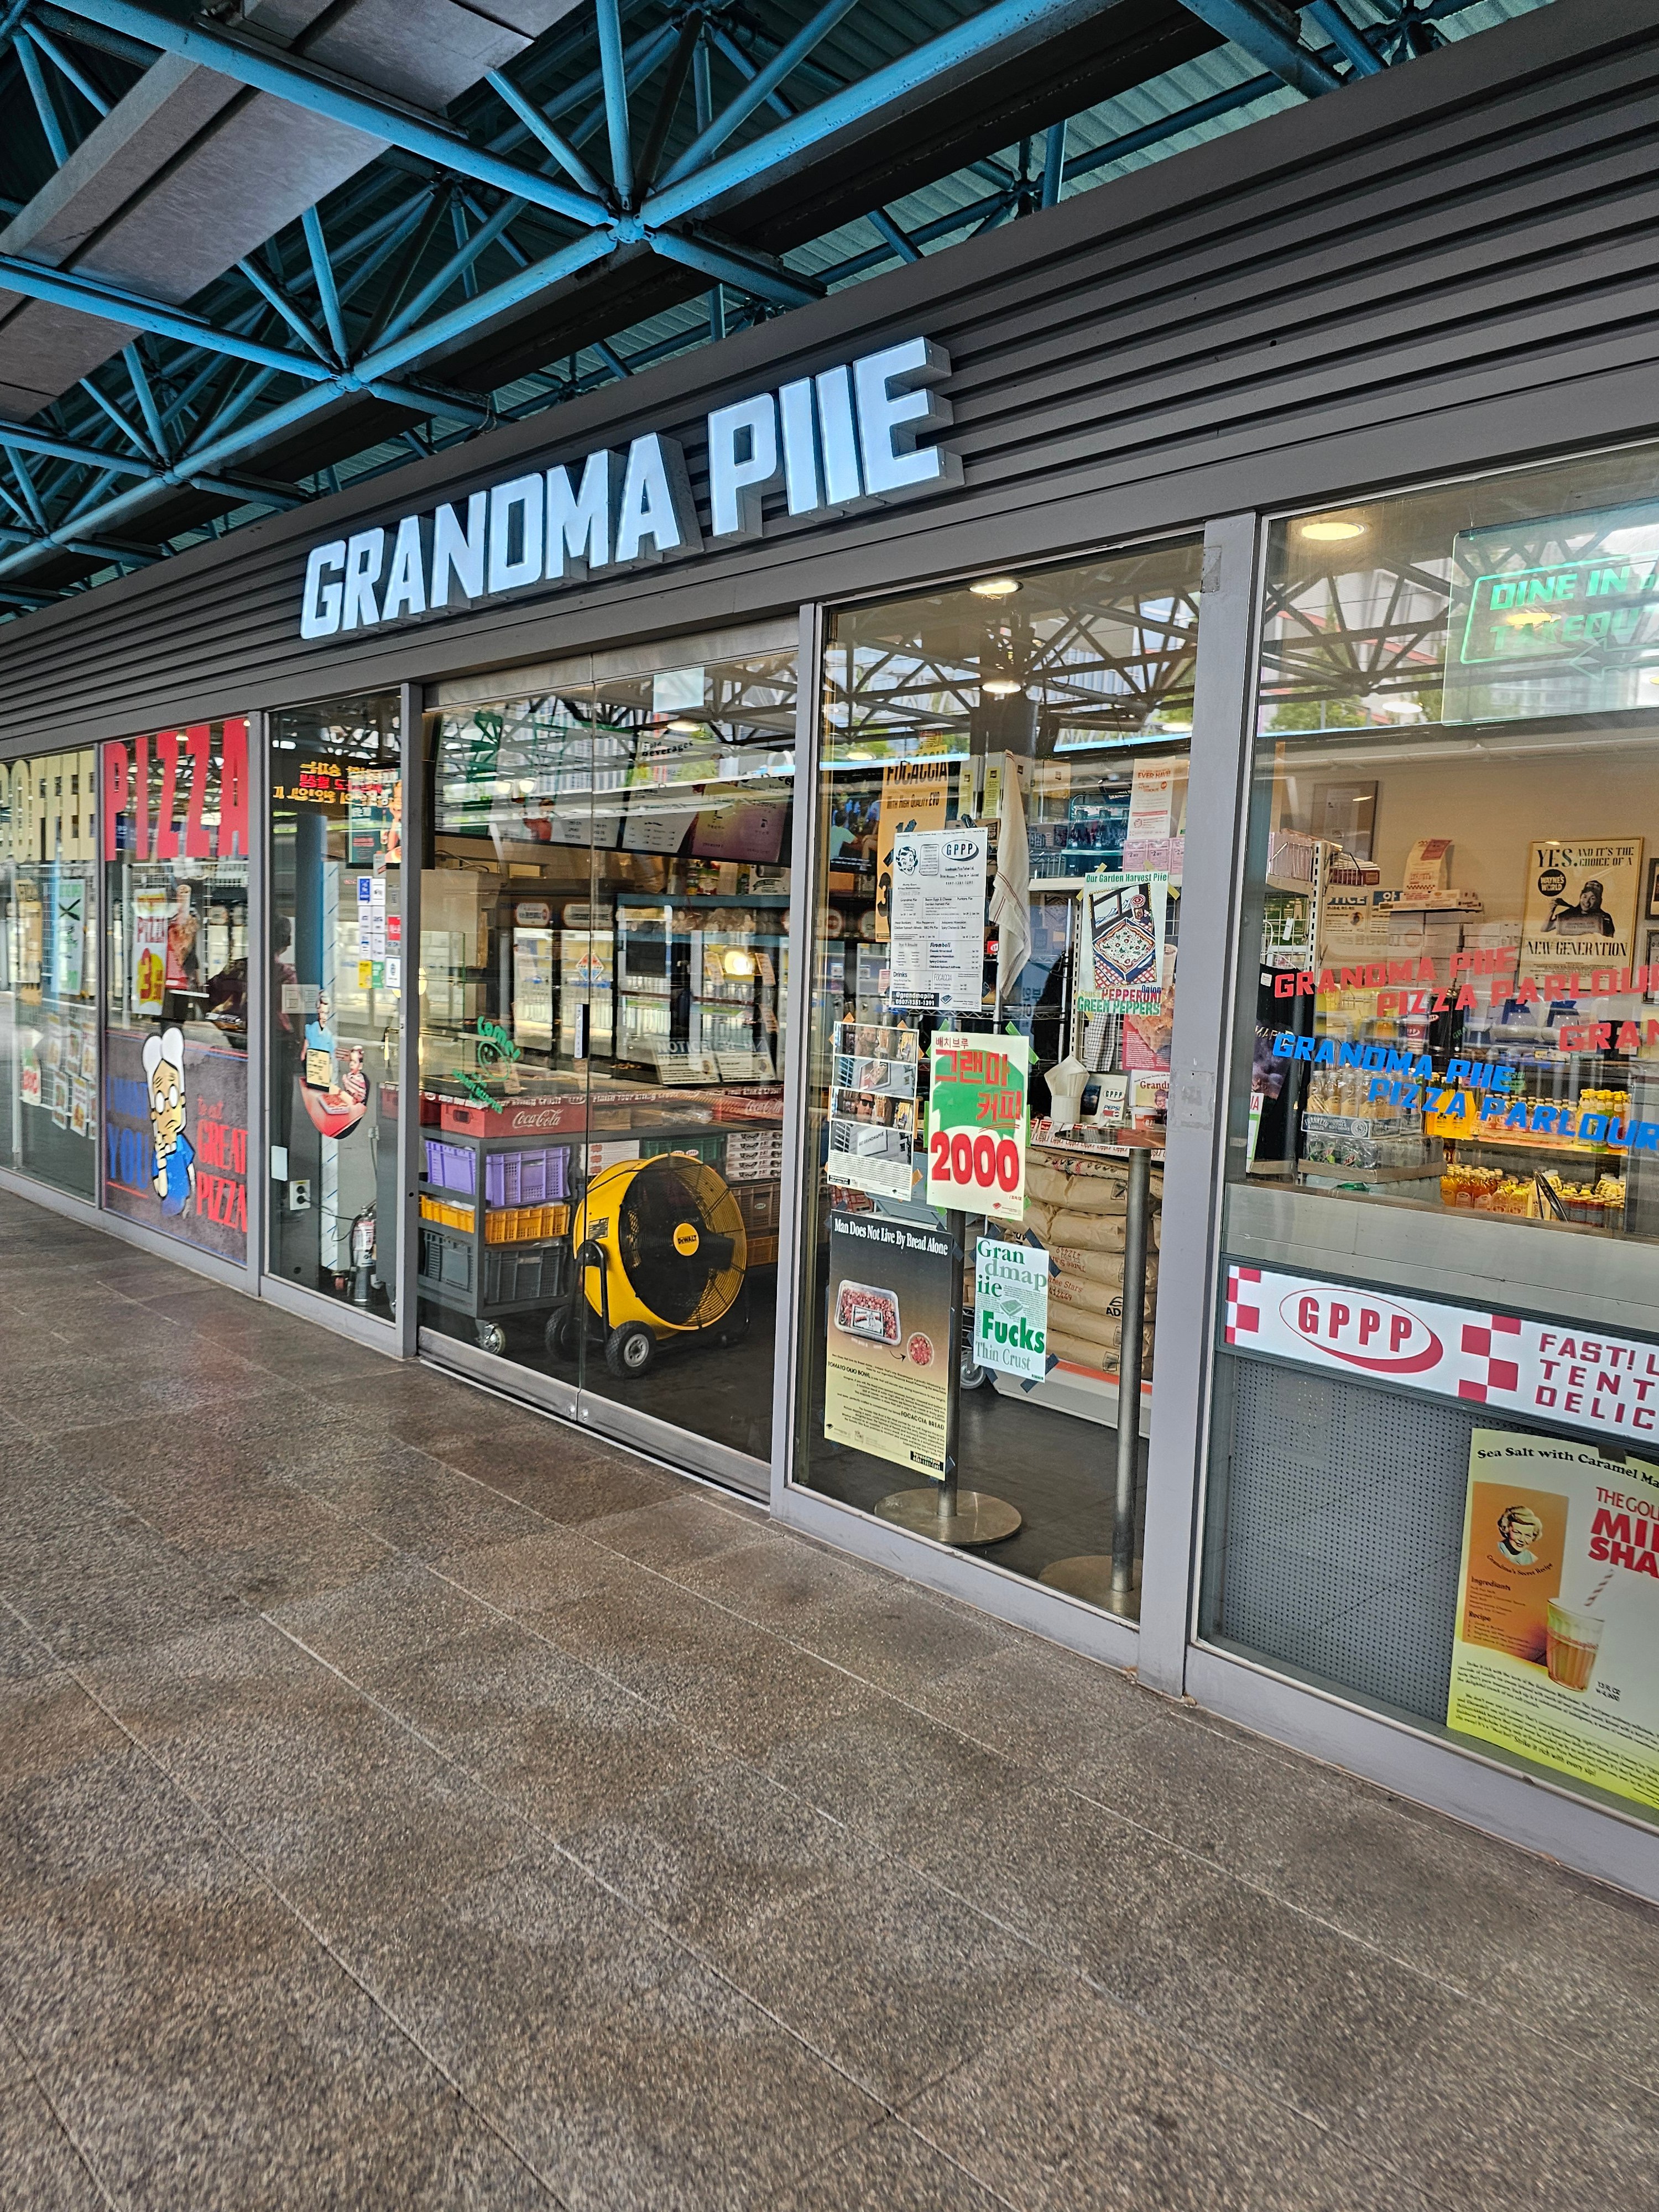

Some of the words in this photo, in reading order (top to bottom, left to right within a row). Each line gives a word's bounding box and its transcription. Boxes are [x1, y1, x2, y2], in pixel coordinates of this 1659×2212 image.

[300, 432, 691, 640] GRANDMA
[708, 336, 954, 539] PIIE
[1490, 573, 1578, 611] DINE
[1585, 566, 1631, 597] IN
[105, 717, 249, 861] PIZZA
[946, 843, 973, 855] GPPP
[1537, 848, 1578, 867] YES.
[1578, 848, 1593, 857] AND
[1596, 848, 1613, 856] IT'S
[1616, 847, 1634, 855] THE
[1579, 858, 1610, 867] CHOICE
[1613, 857, 1624, 866] OF
[1627, 857, 1632, 865] A
[1086, 874, 1098, 883] Our
[1099, 874, 1124, 883] Garden
[1125, 873, 1152, 882] Harvest
[1541, 875, 1564, 884] WAYNE'S
[1526, 940, 1551, 954] NEW
[1556, 941, 1628, 957] GENERATION
[1274, 957, 1437, 998] GRANDMA
[1450, 946, 1518, 978] PIIE
[1077, 996, 1110, 1013] GREEN
[1113, 999, 1160, 1015] PEPPERS
[1081, 989, 1101, 998] Sausa
[1378, 984, 1478, 1017] PIZZA
[936, 1037, 969, 1049] 배치브루
[935, 1048, 1010, 1088] 그랜마
[1272, 1033, 1432, 1080] GRANDMA
[1446, 1058, 1516, 1093] PIIE
[976, 1090, 1022, 1123] 커피
[1105, 1091, 1123, 1099] GPPP
[512, 1108, 565, 1129] Coca-Cola
[1368, 1078, 1465, 1118] PIZZA
[1481, 1096, 1659, 1151] PARLOUR
[107, 1122, 149, 1189] YOU
[196, 1118, 248, 1175] GREAT
[930, 1131, 1019, 1193] 2000
[196, 1171, 248, 1233] PIZZA
[834, 1218, 849, 1234] Man
[849, 1221, 867, 1238] Does
[867, 1225, 880, 1241] Not
[881, 1227, 895, 1244] Live
[896, 1230, 906, 1250] By
[906, 1233, 927, 1251] Bread
[926, 1237, 948, 1256] Alone
[978, 1240, 1025, 1265] Gran
[977, 1274, 1002, 1297] iie
[984, 1259, 1047, 1292] dmap
[1064, 1280, 1084, 1293] Stars
[1106, 1307, 1121, 1317] AD
[1298, 1296, 1412, 1353] GPPP
[982, 1310, 1045, 1354] Fucks
[975, 1340, 999, 1365] Thin
[1002, 1348, 1031, 1371] Crust
[1539, 1333, 1636, 1371] FAST!
[828, 1361, 846, 1371] TOMATO
[858, 1368, 871, 1379] BOWL
[901, 1411, 927, 1425] FOCACCIA
[928, 1418, 945, 1430] BREAD
[1535, 1384, 1656, 1430] DELIC
[1477, 1448, 1502, 1458] Sea
[1505, 1447, 1534, 1457] Salt
[1538, 1449, 1574, 1462] with
[1578, 1453, 1638, 1479] Caramel
[1596, 1486, 1625, 1509] THE
[1625, 1496, 1659, 1521] GOL
[1471, 1576, 1511, 1591] Ingredients
[1468, 1610, 1491, 1622] Recipe
